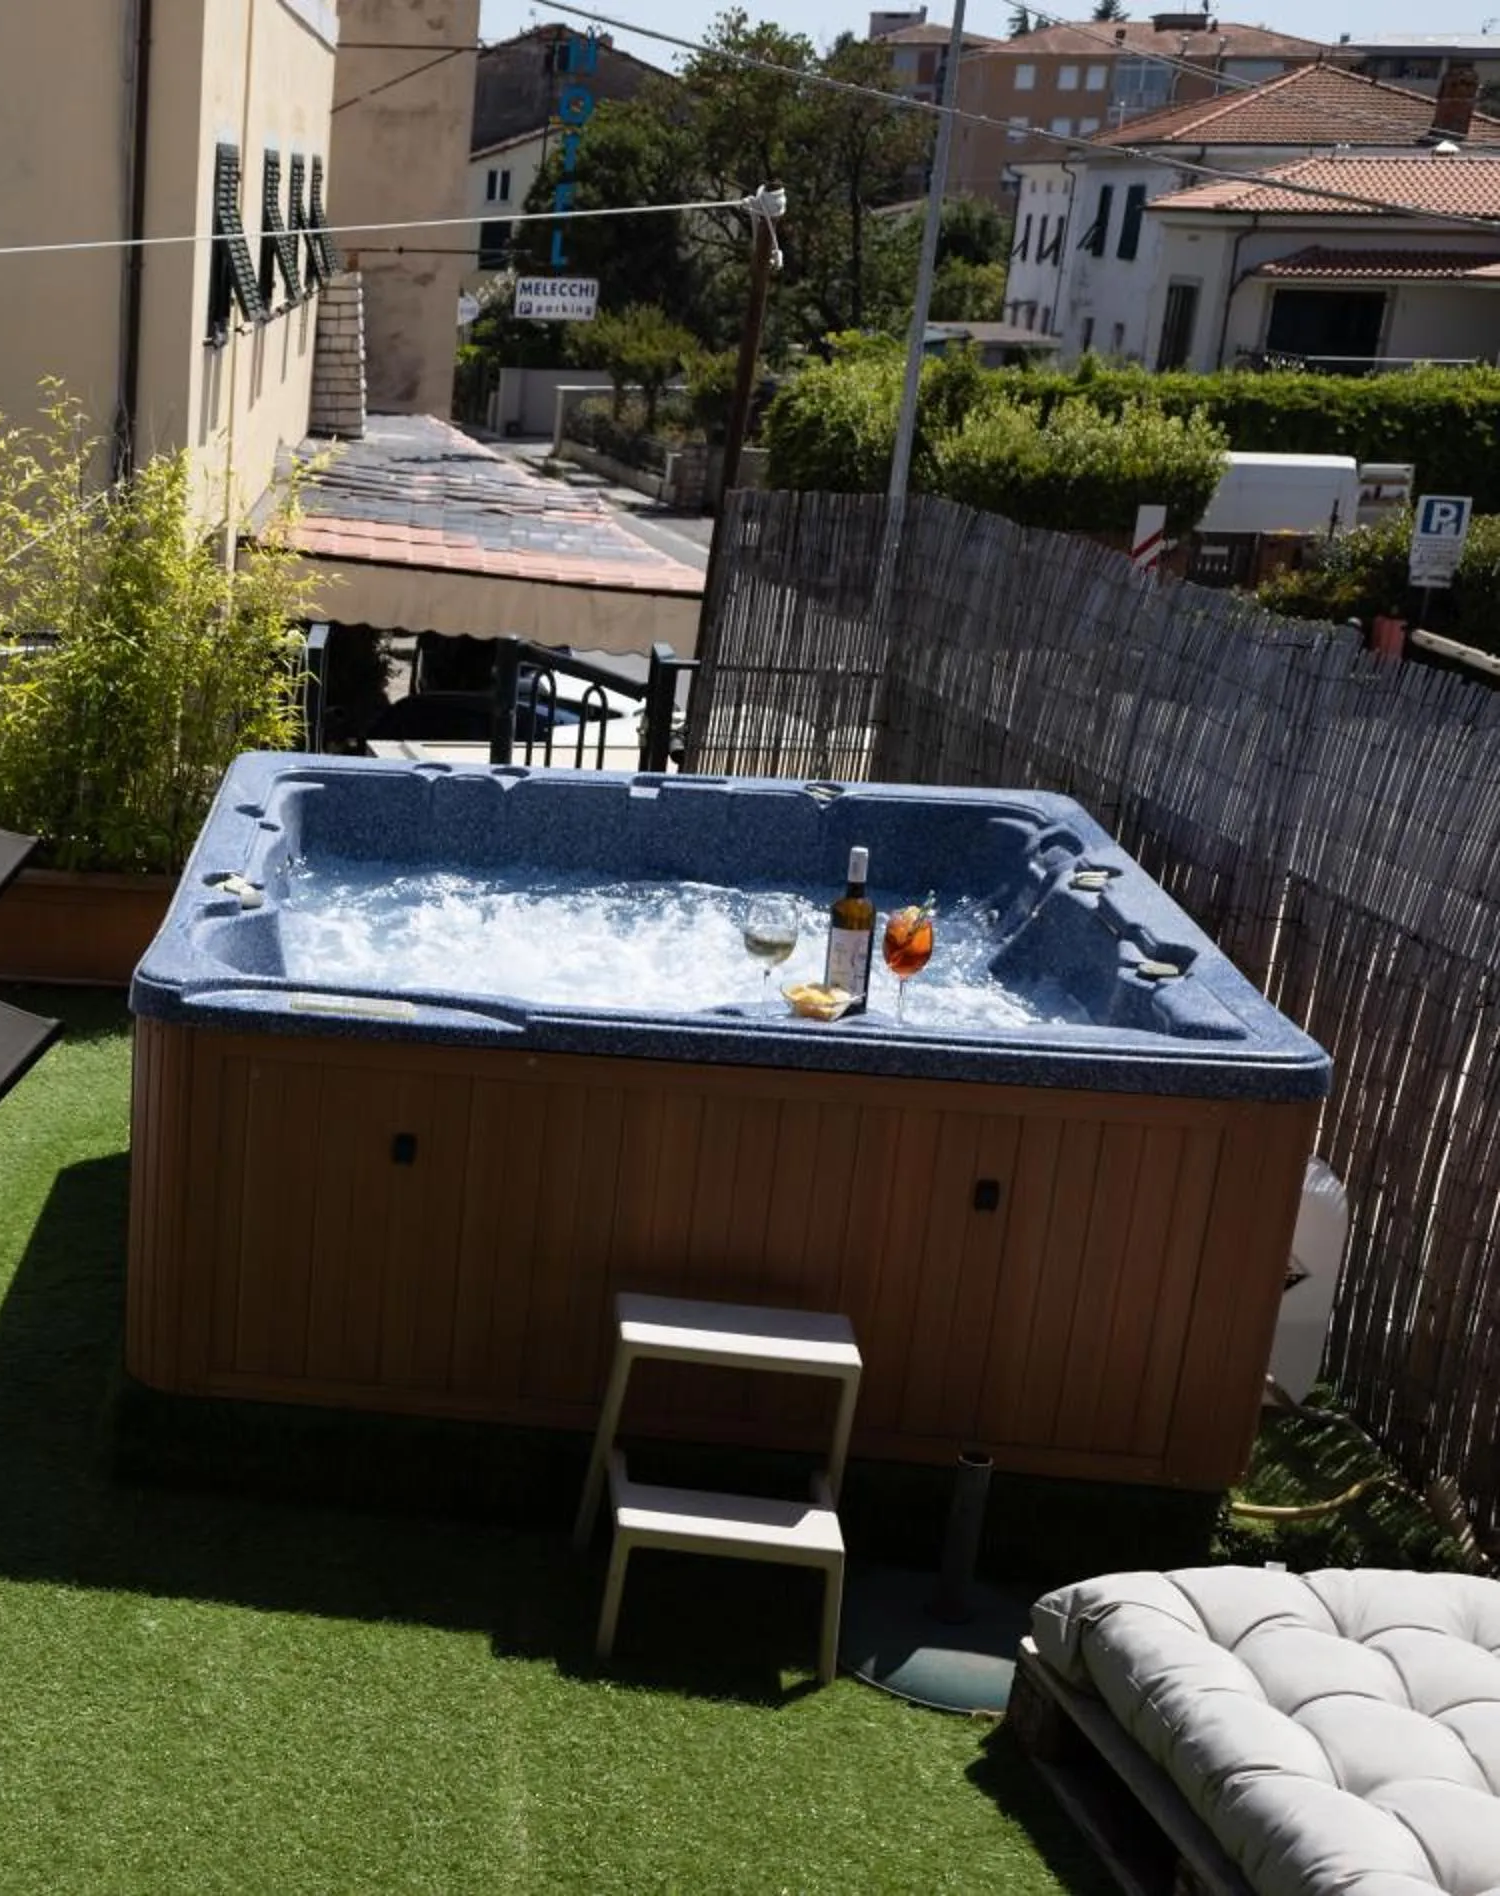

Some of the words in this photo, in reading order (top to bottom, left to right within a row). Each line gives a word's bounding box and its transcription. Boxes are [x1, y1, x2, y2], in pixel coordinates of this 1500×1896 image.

[520, 282, 596, 297] MELECCHI
[537, 303, 592, 316] parking
[1429, 502, 1457, 532] P
